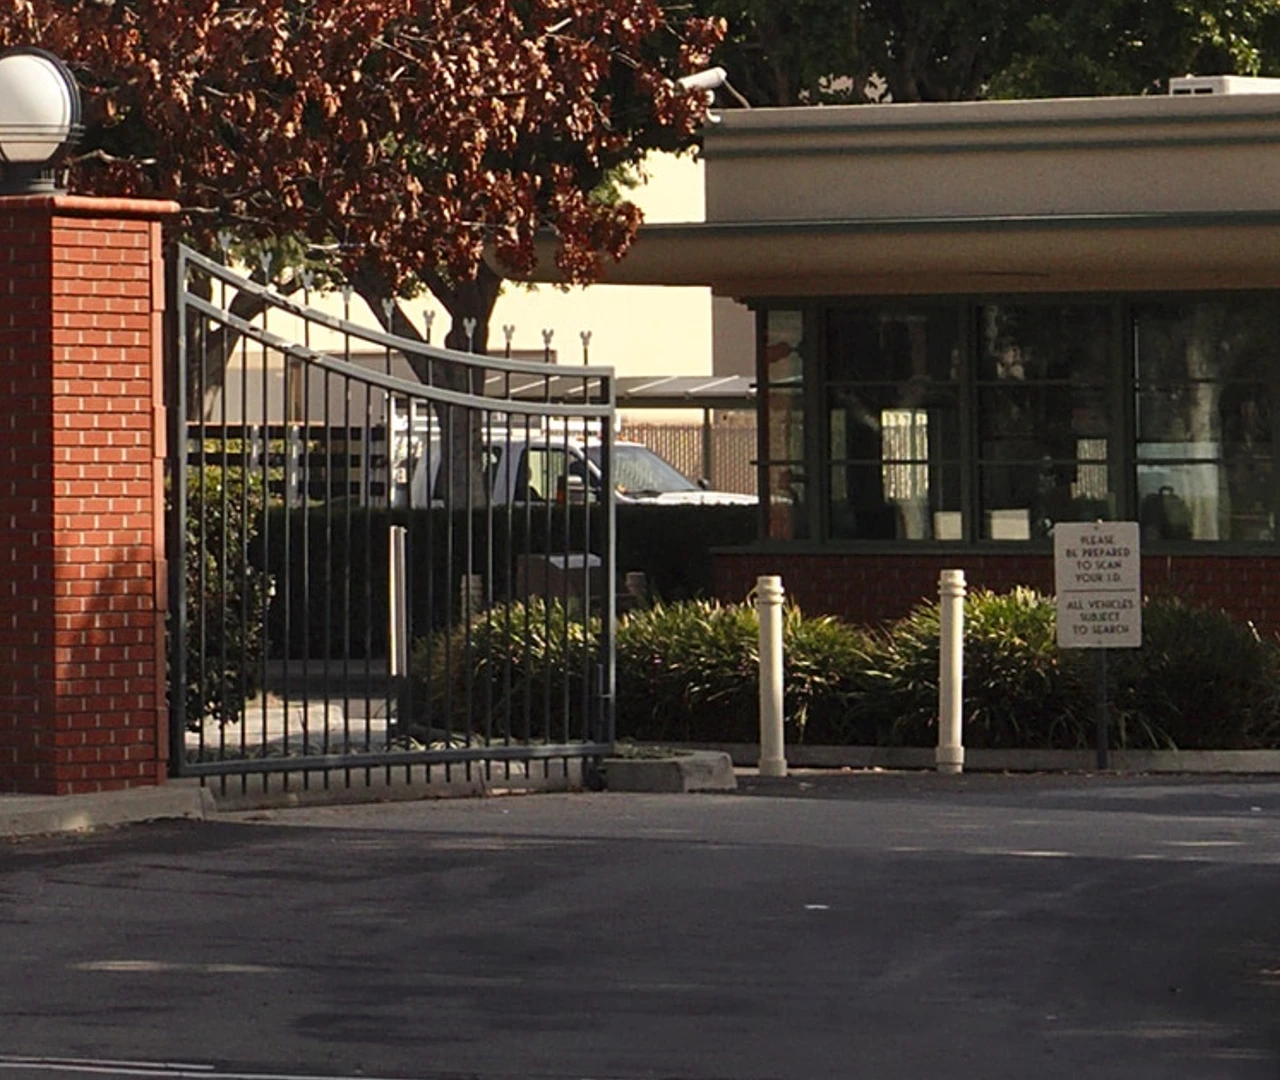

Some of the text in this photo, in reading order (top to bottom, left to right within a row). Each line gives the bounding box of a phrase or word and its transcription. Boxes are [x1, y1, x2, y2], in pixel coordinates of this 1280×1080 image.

[1080, 536, 1114, 545] PLEASE
[1065, 549, 1131, 558] BE PREPARED
[1077, 561, 1122, 571] TO SCAN
[1075, 574, 1103, 583] YOUR
[1066, 600, 1134, 610] ALL VEHICLES
[1080, 613, 1121, 622] SUBJECT
[1073, 625, 1129, 635] TO SEARCH
